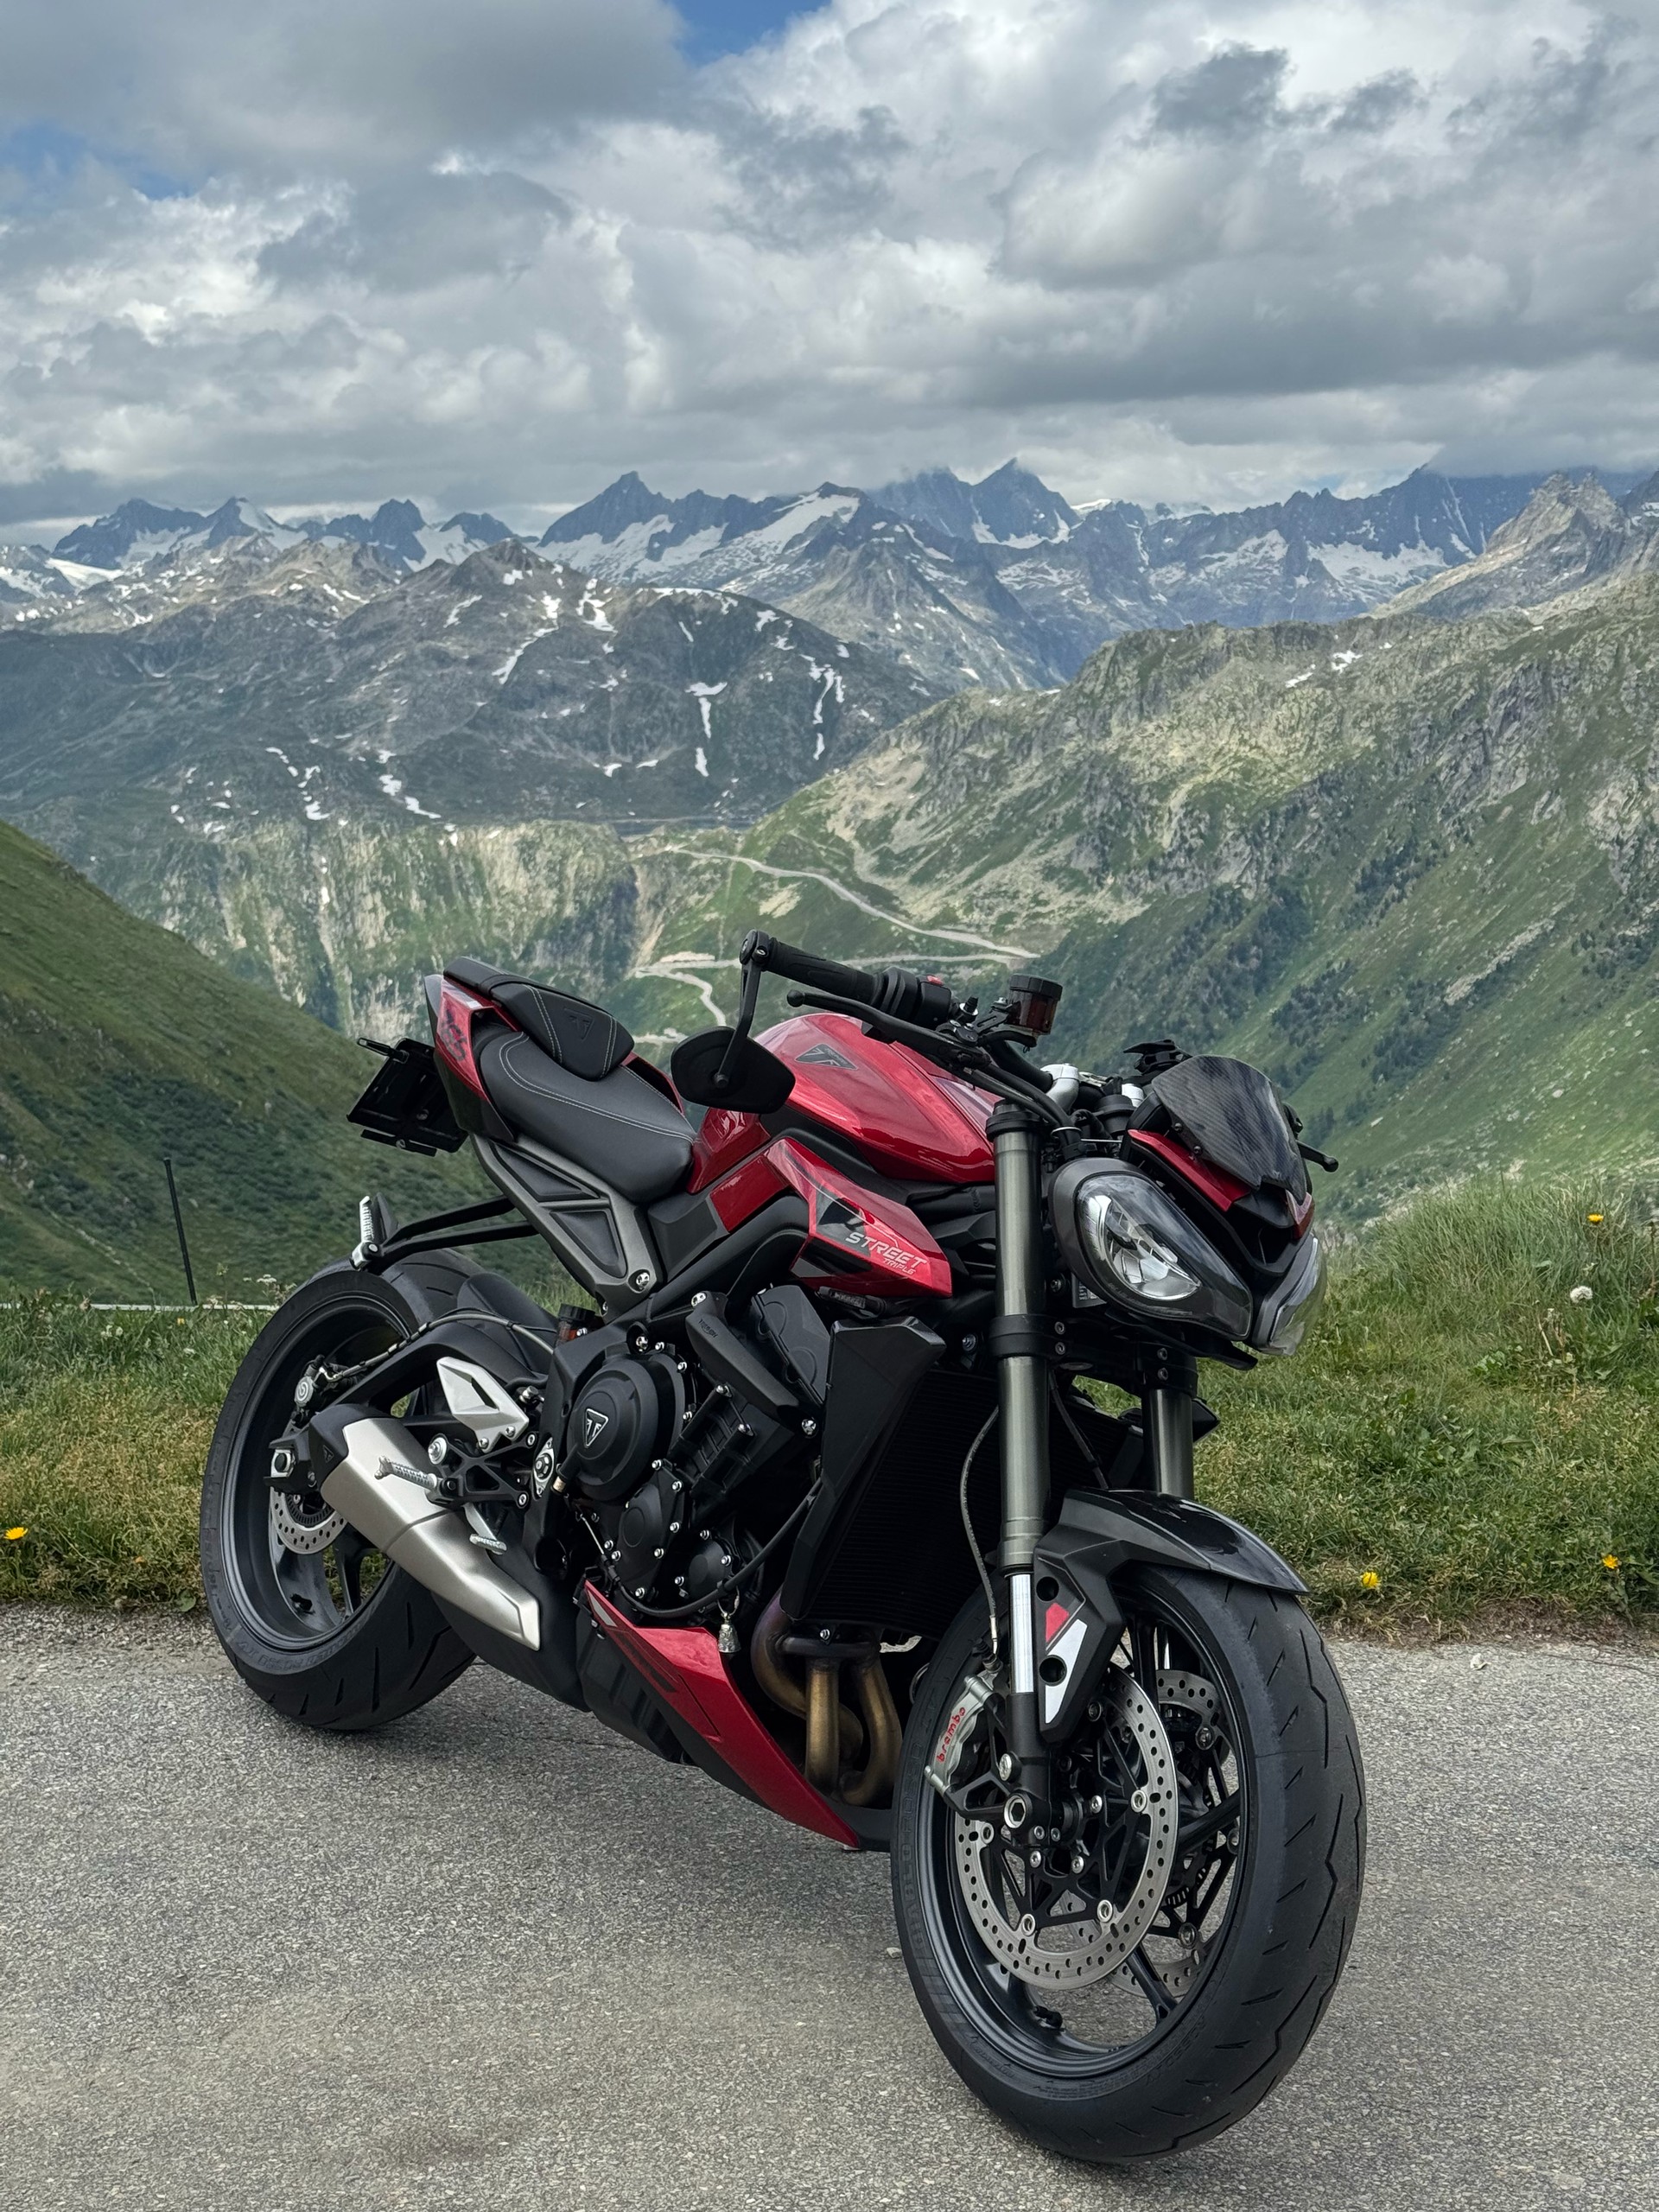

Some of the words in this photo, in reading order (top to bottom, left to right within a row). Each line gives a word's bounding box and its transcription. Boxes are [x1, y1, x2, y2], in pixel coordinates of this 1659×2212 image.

[845, 1231, 927, 1268] STREET
[883, 1258, 916, 1275] TRIPLE
[937, 1707, 966, 1763] brembo
